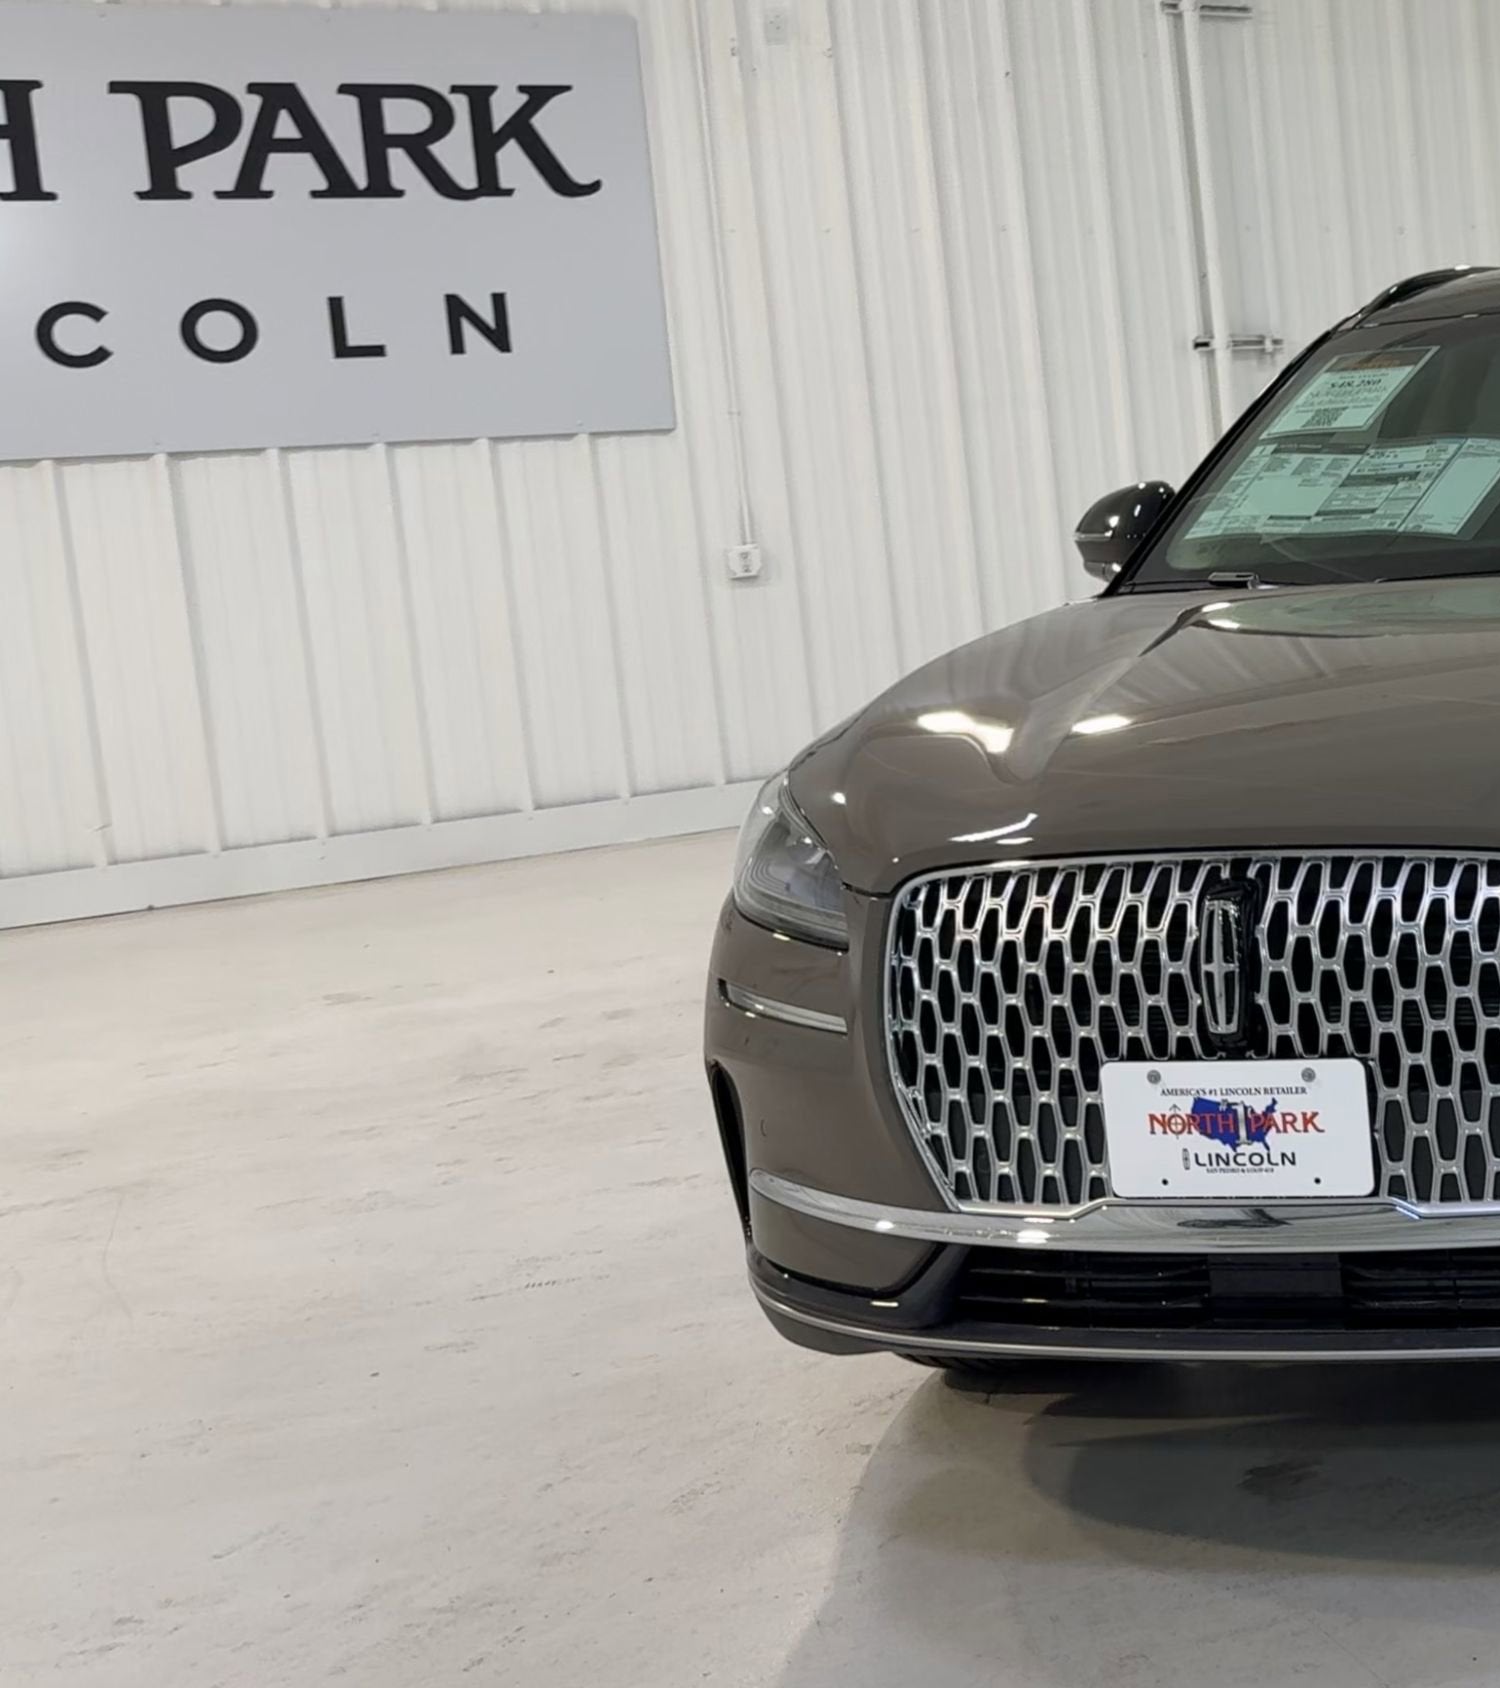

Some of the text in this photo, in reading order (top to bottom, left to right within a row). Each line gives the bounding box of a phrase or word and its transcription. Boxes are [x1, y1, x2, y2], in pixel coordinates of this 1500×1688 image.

[108, 81, 602, 201] PARK
[1160, 1088, 1207, 1097] AMERICA'S
[1220, 1087, 1262, 1096] LINCOLN
[1263, 1086, 1308, 1096] RETAILER
[1148, 1111, 1235, 1136] NORTH
[1250, 1111, 1326, 1134] PARK
[1194, 1152, 1297, 1167] LINCOLN
